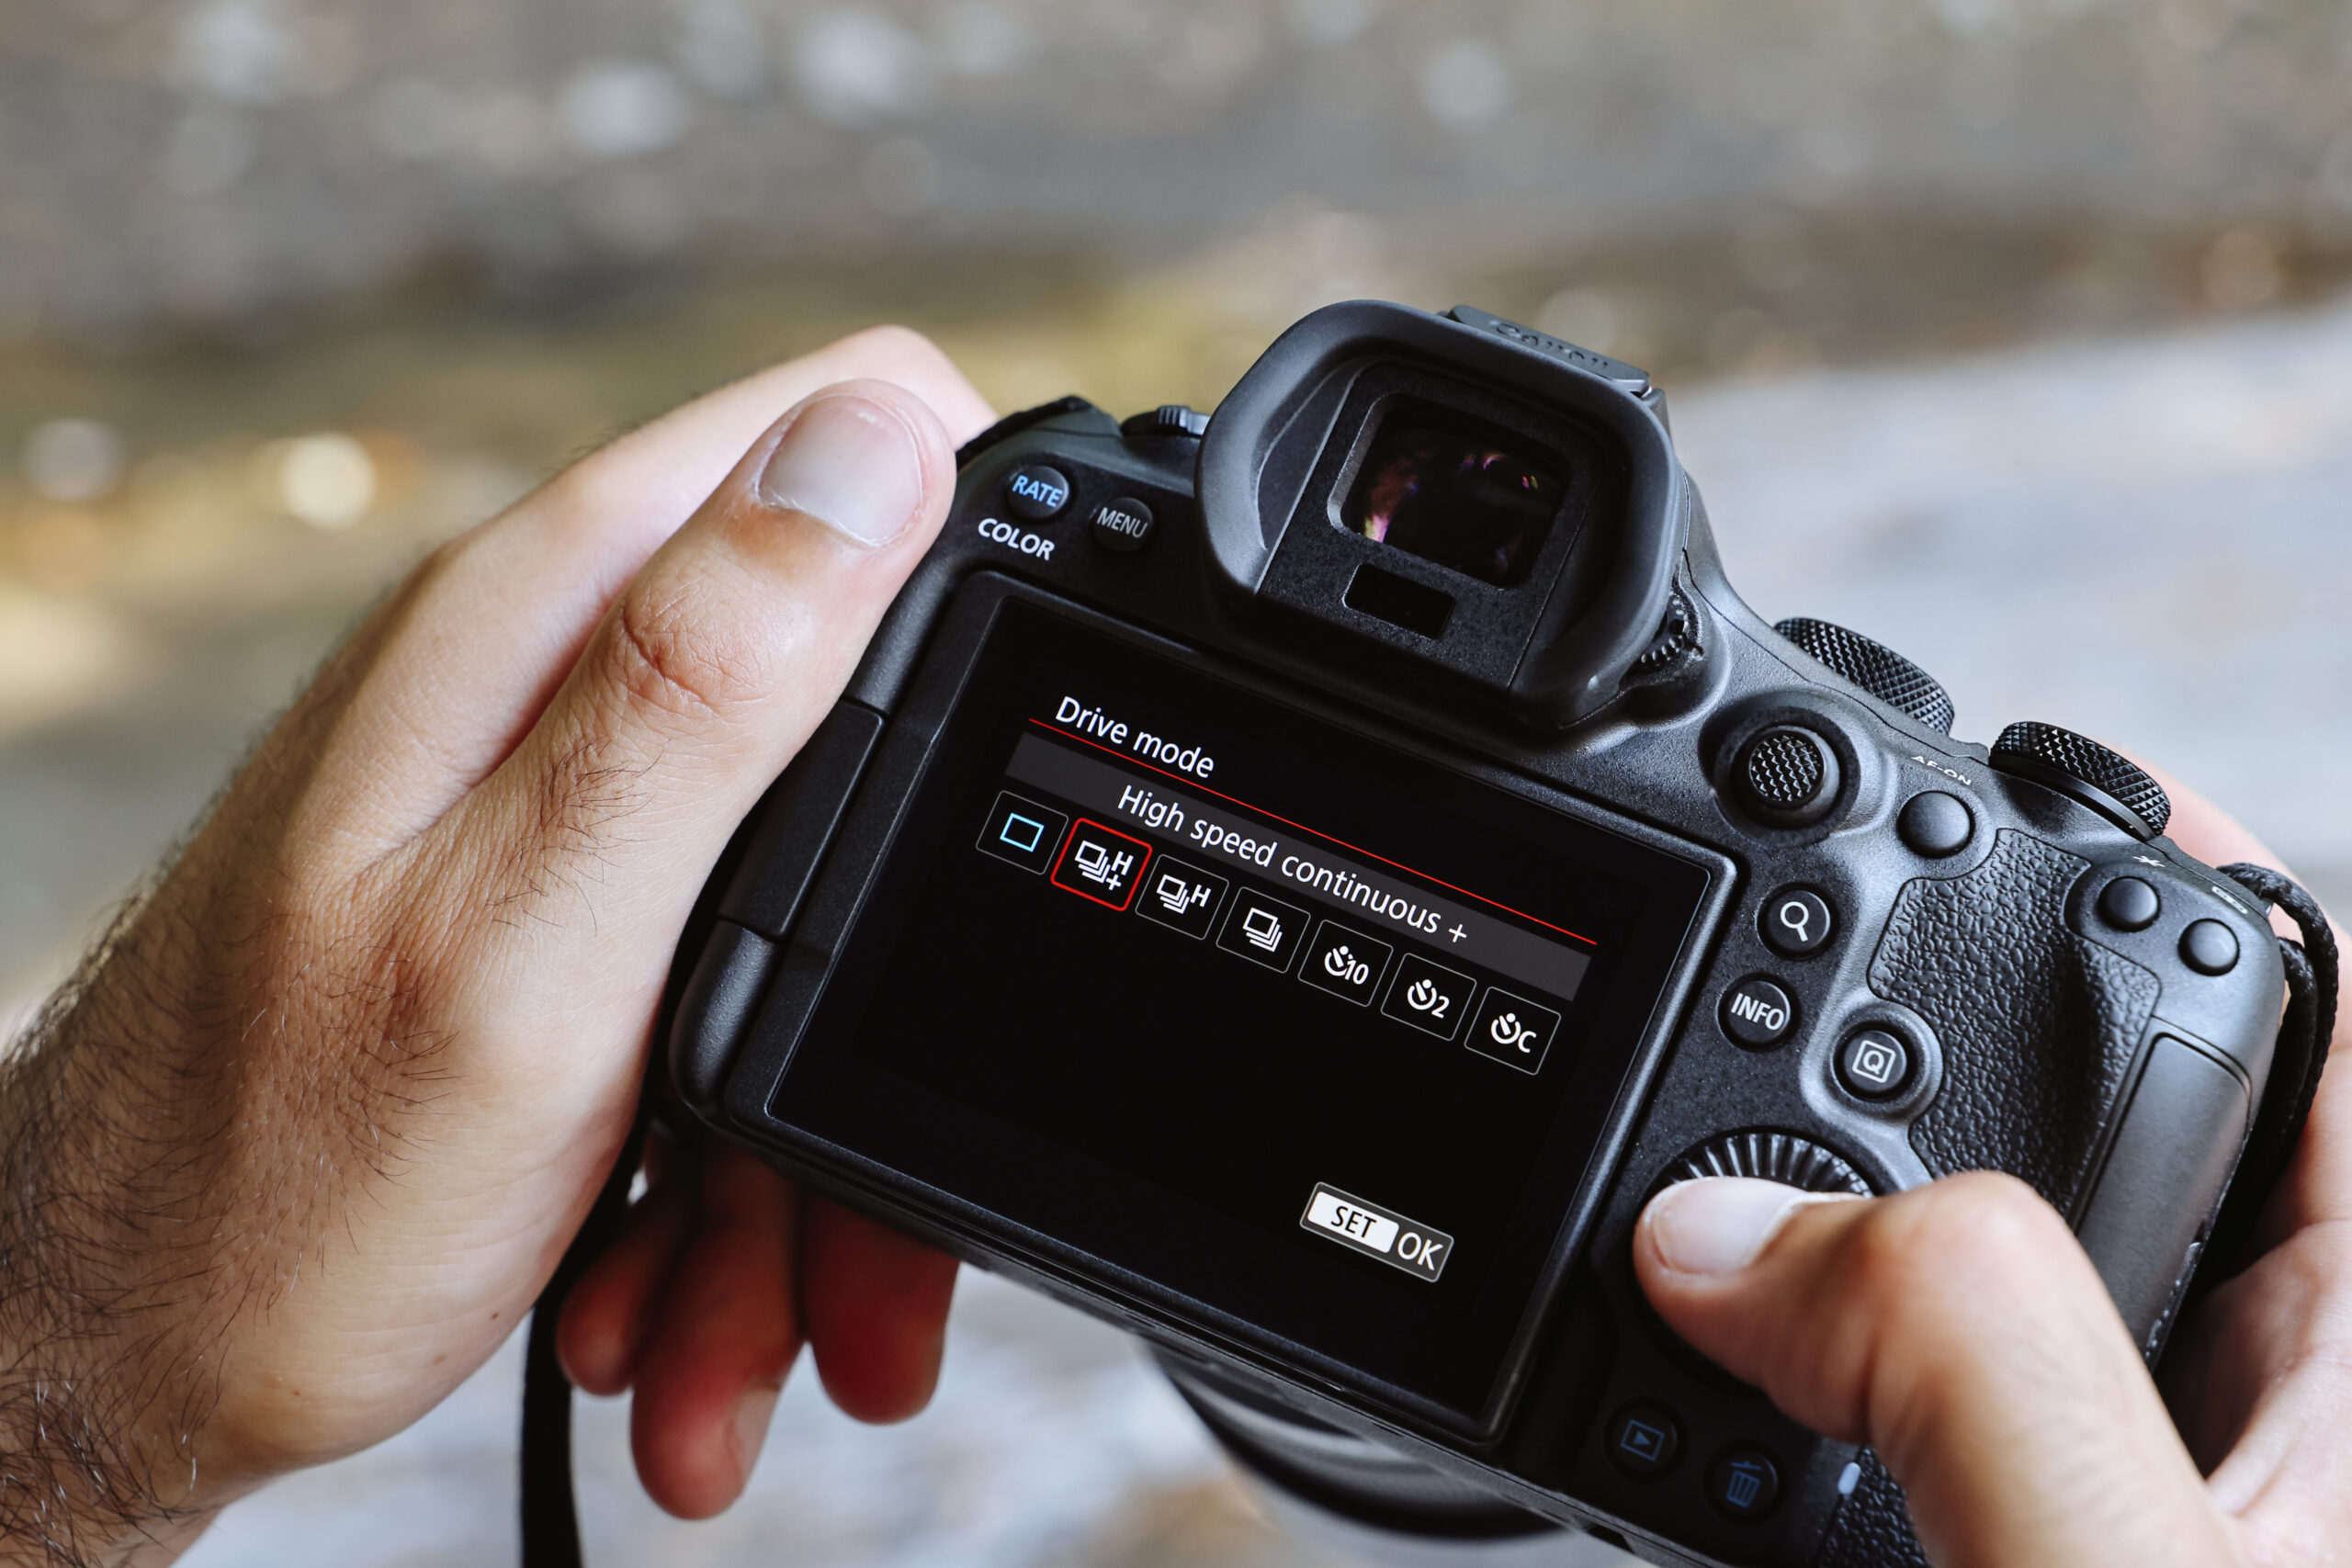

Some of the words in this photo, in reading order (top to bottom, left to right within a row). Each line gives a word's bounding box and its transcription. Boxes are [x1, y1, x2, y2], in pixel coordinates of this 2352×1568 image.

[1012, 474, 1064, 508] RATE
[978, 517, 1056, 561] COLOR
[1096, 507, 1148, 539] MENU
[1055, 695, 1128, 744] Drive
[1133, 730, 1215, 778] mode
[1911, 755, 1973, 786] AF-ON
[1117, 784, 1185, 831] High
[1190, 818, 1277, 867] speed
[1282, 853, 1442, 933] continuous
[1431, 995, 1451, 1019] 2
[1730, 992, 1785, 1031] INFO
[1862, 1049, 1885, 1075] Q
[1330, 1205, 1377, 1238] SET
[1397, 1232, 1444, 1271] OK
